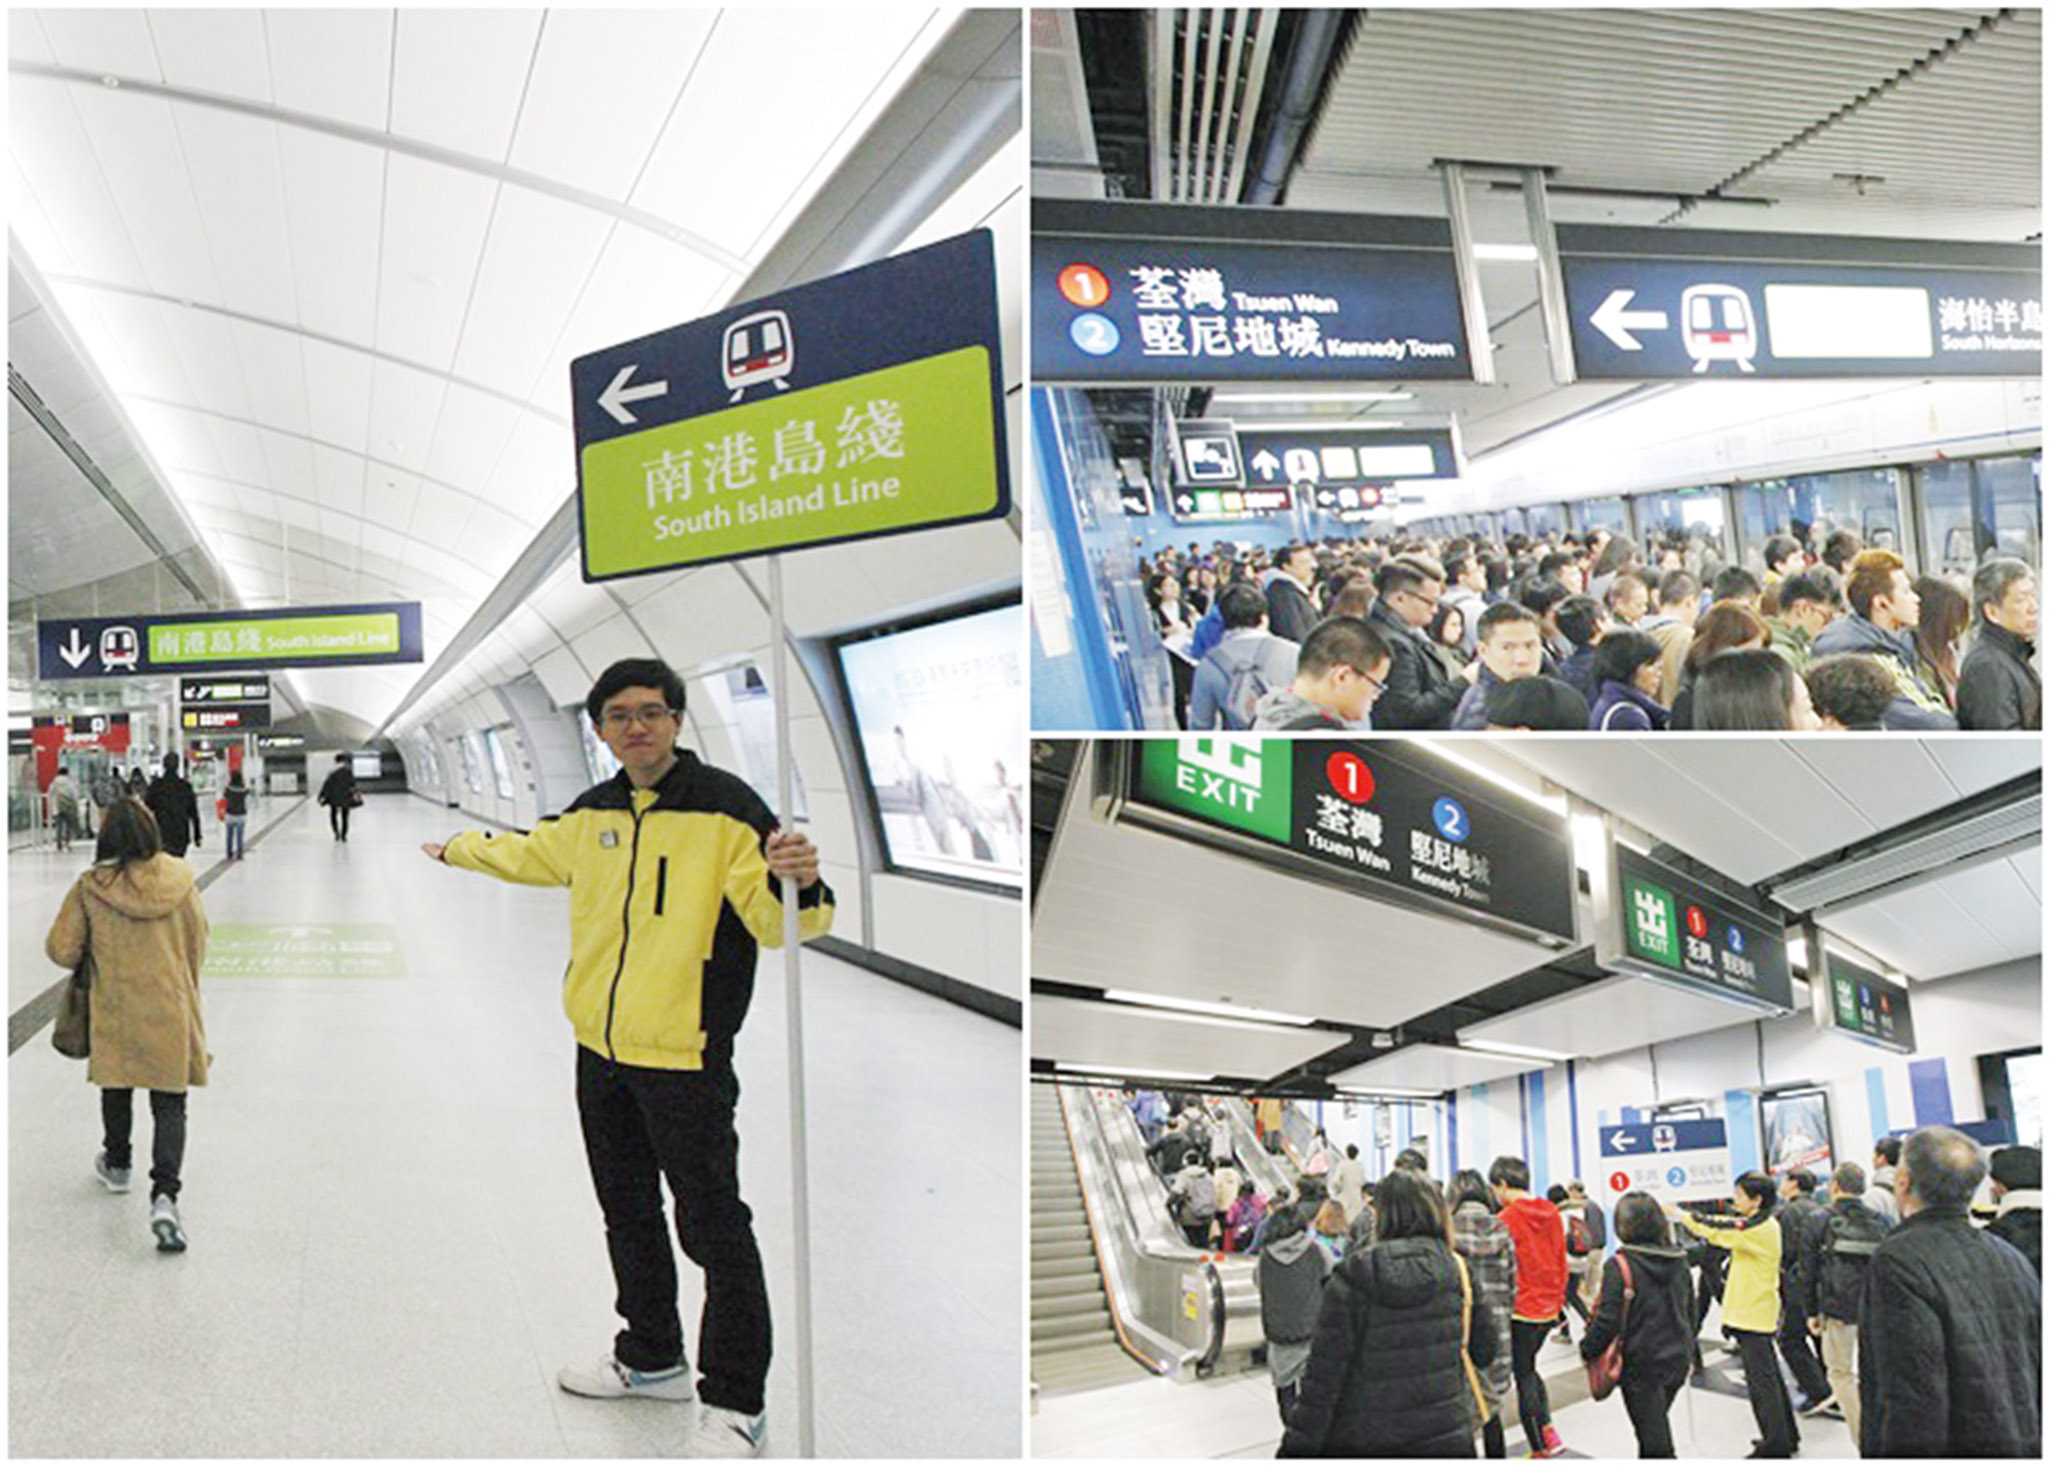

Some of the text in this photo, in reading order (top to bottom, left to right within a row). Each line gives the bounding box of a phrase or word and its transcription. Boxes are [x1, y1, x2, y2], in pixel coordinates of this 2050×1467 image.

[1128, 265, 1228, 311] 荃灣
[1231, 291, 1292, 313] Tsuen
[1293, 294, 1340, 314] Wan
[1138, 313, 1325, 358] 堅尼地城
[1326, 337, 1405, 361] Kennedy
[1405, 338, 1456, 358] Town
[1941, 333, 1982, 351] South
[641, 399, 905, 510] 南港島綫
[653, 476, 901, 541] South Island Line
[358, 630, 391, 647] Line
[1176, 763, 1262, 813] EXIT
[1316, 793, 1384, 848] 荃灣
[1305, 828, 1391, 872] Tsuen Wan
[1634, 889, 1668, 938] 出
[1638, 930, 1669, 955] EXIT
